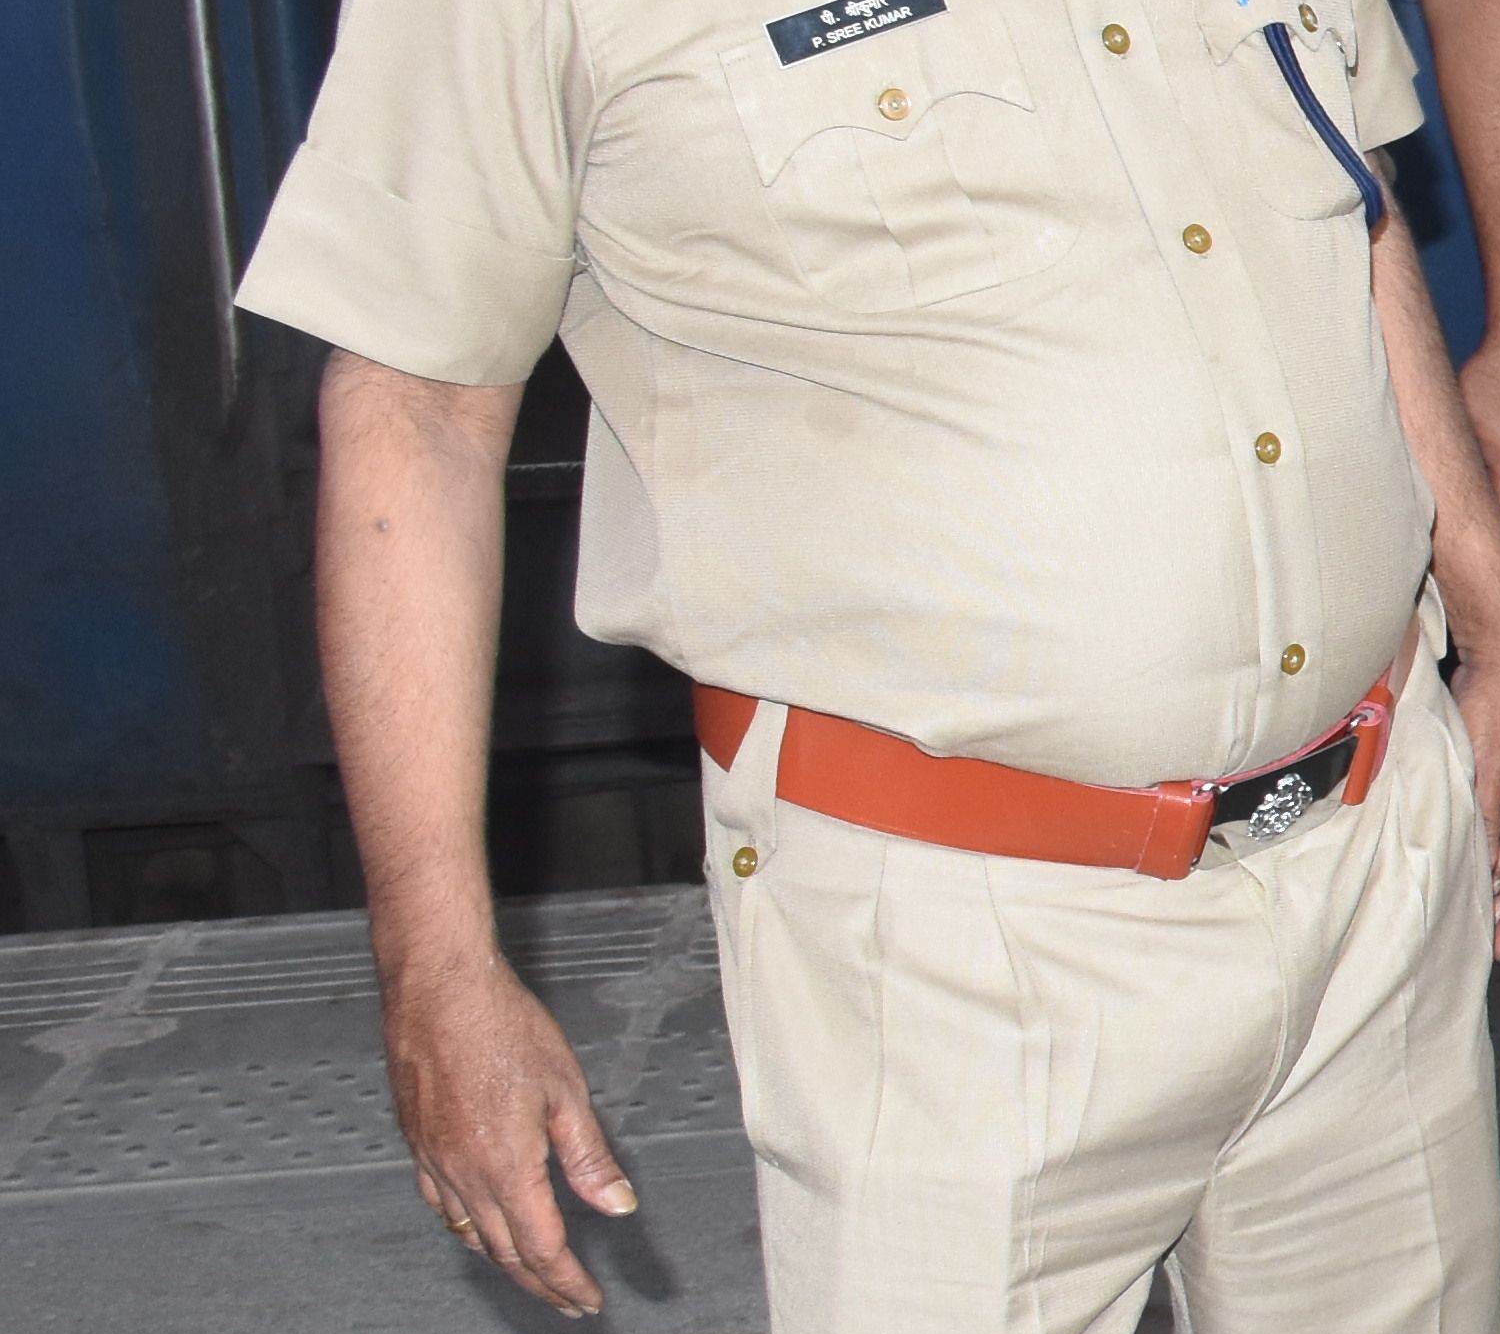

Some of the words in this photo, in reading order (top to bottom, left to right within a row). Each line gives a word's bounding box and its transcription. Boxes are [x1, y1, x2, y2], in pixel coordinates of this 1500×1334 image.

[811, 36, 827, 49] P.
[826, 22, 864, 44] SREE
[864, 6, 913, 31] KUMAR
